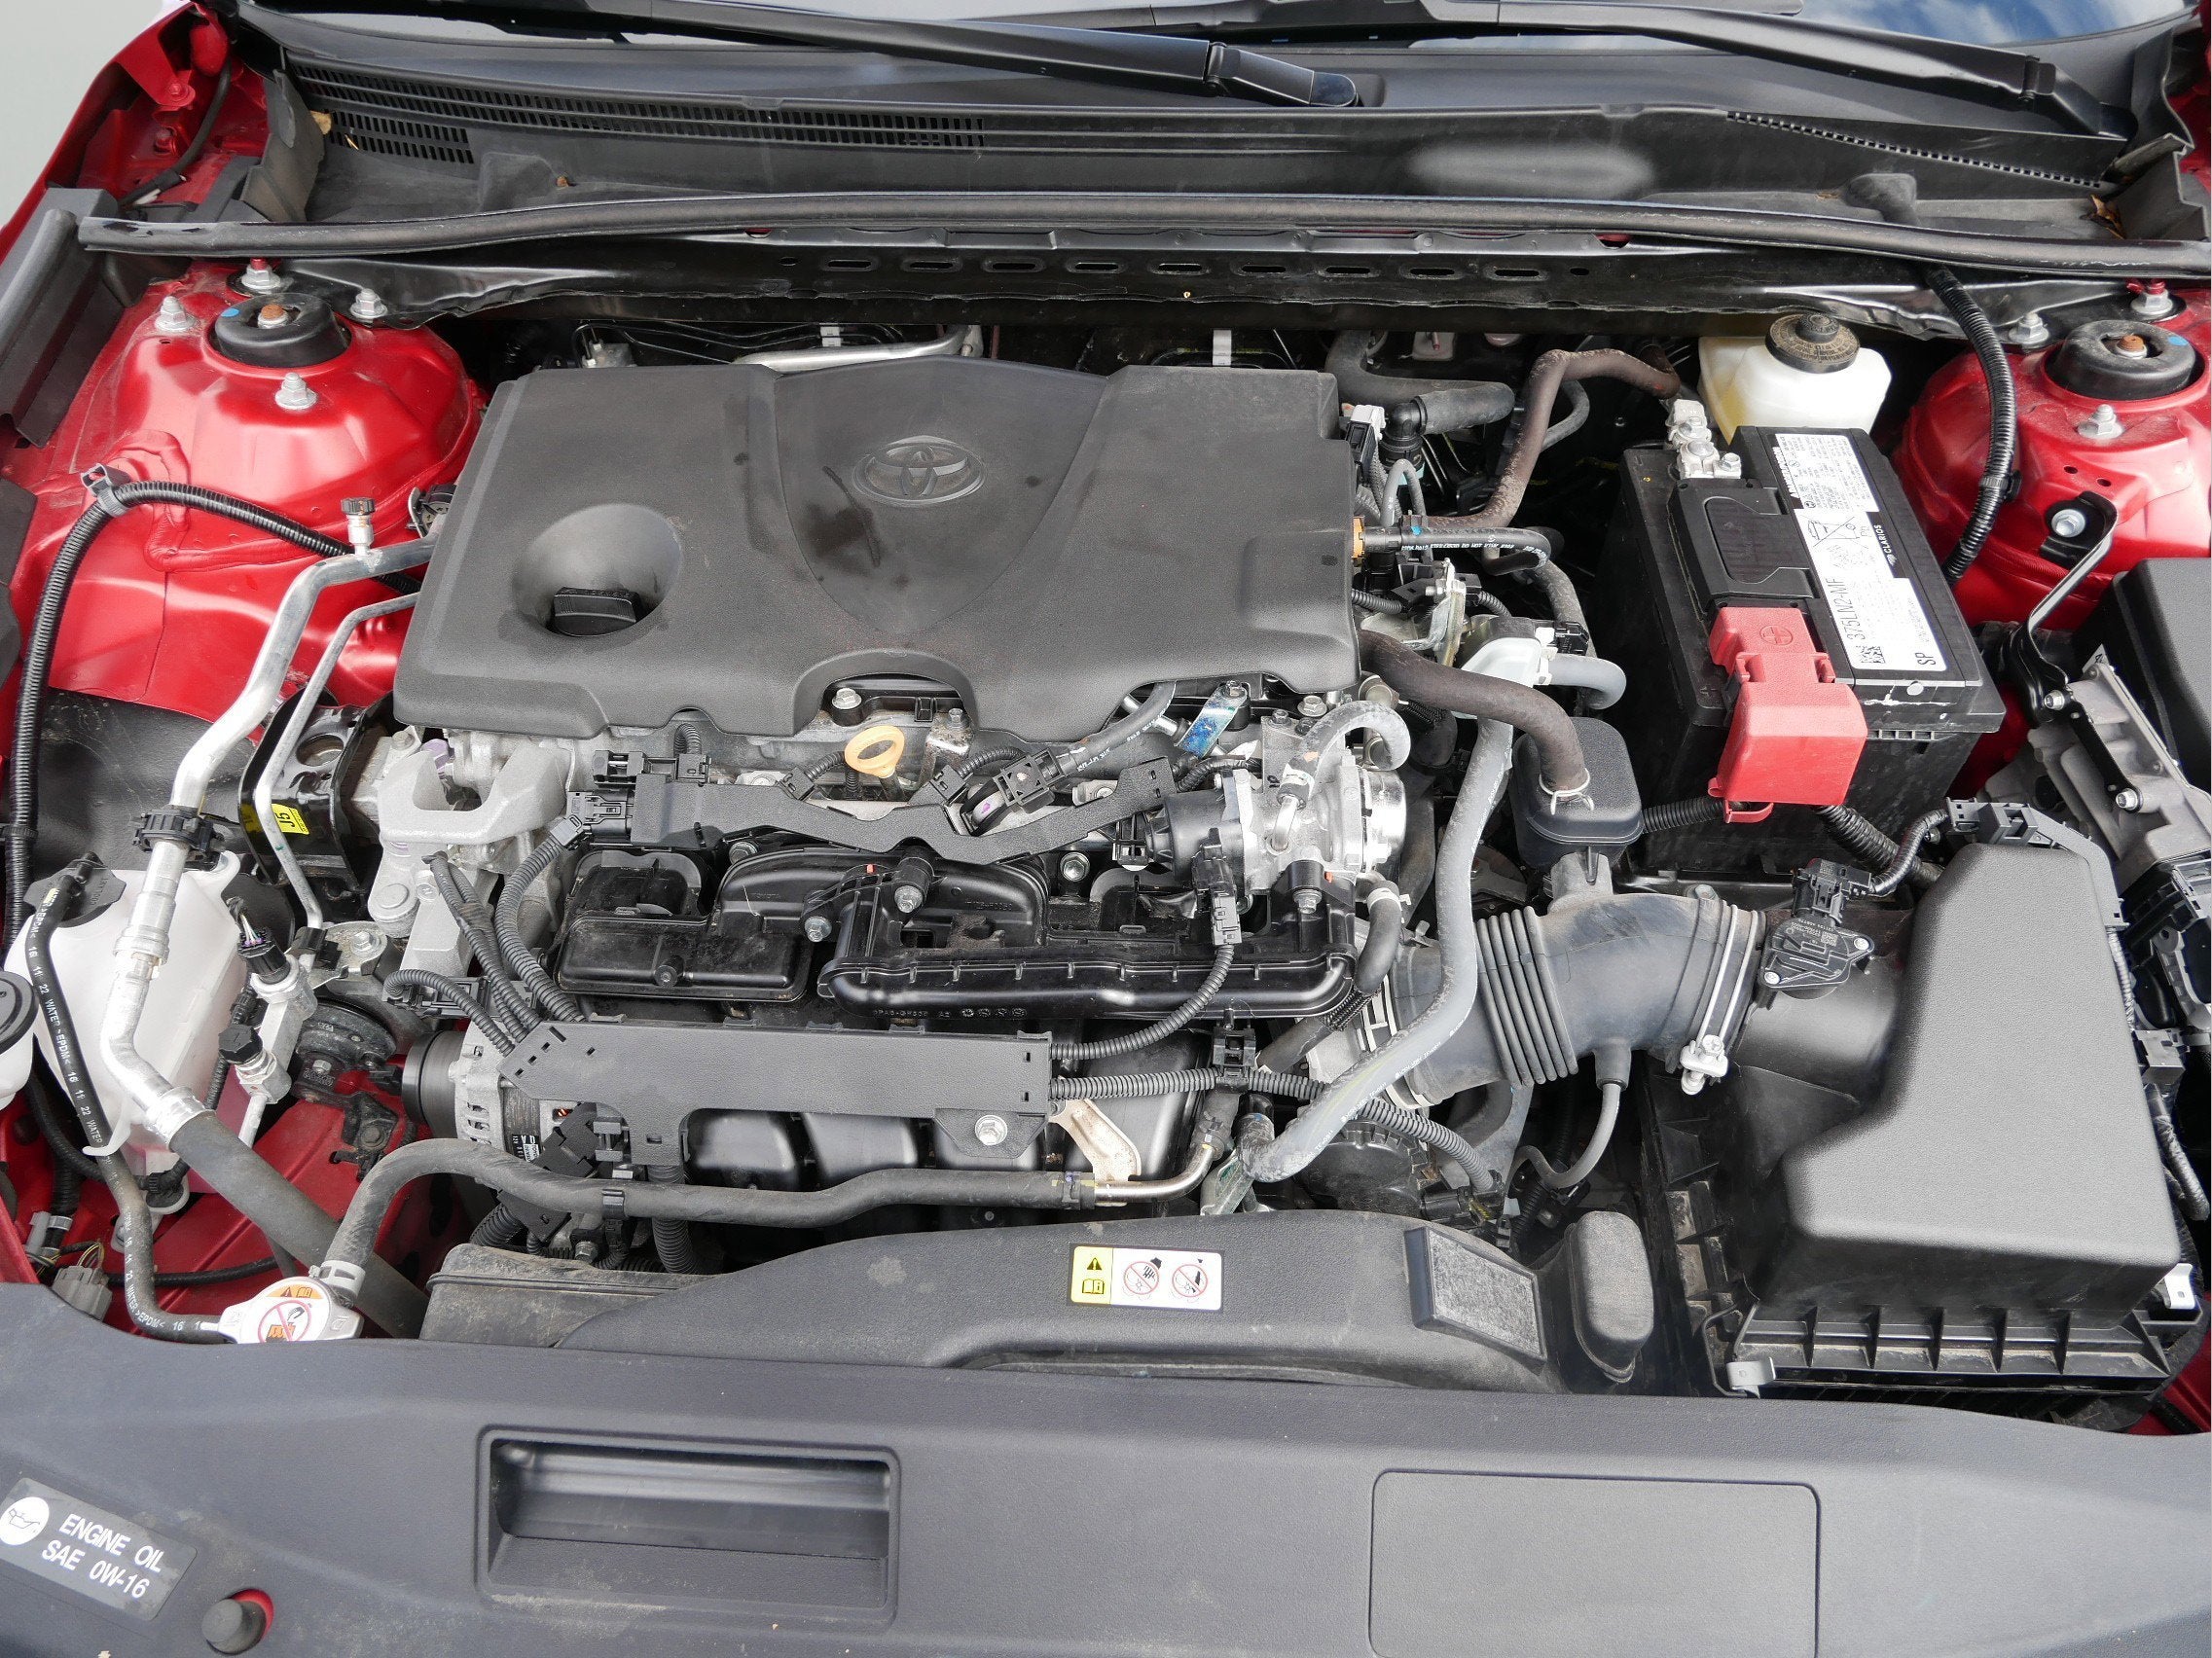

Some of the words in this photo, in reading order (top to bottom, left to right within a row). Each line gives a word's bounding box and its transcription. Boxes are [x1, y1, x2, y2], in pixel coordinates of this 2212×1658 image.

[1873, 523, 1892, 555] CLARIOS
[1825, 578, 1866, 641] 375LN2-MF
[1914, 652, 1937, 666] SP
[274, 812, 296, 828] J5
[39, 984, 50, 994] 22
[45, 998, 61, 1027] WATER
[81, 1105, 91, 1116] 22
[86, 1120, 103, 1144] WATER
[126, 1284, 139, 1315] WATER
[172, 1320, 185, 1331] 16
[41, 1539, 86, 1571] SAE
[89, 1560, 150, 1599] 0W-16
[58, 1513, 131, 1557] ENGINE
[133, 1545, 165, 1573] OIL
